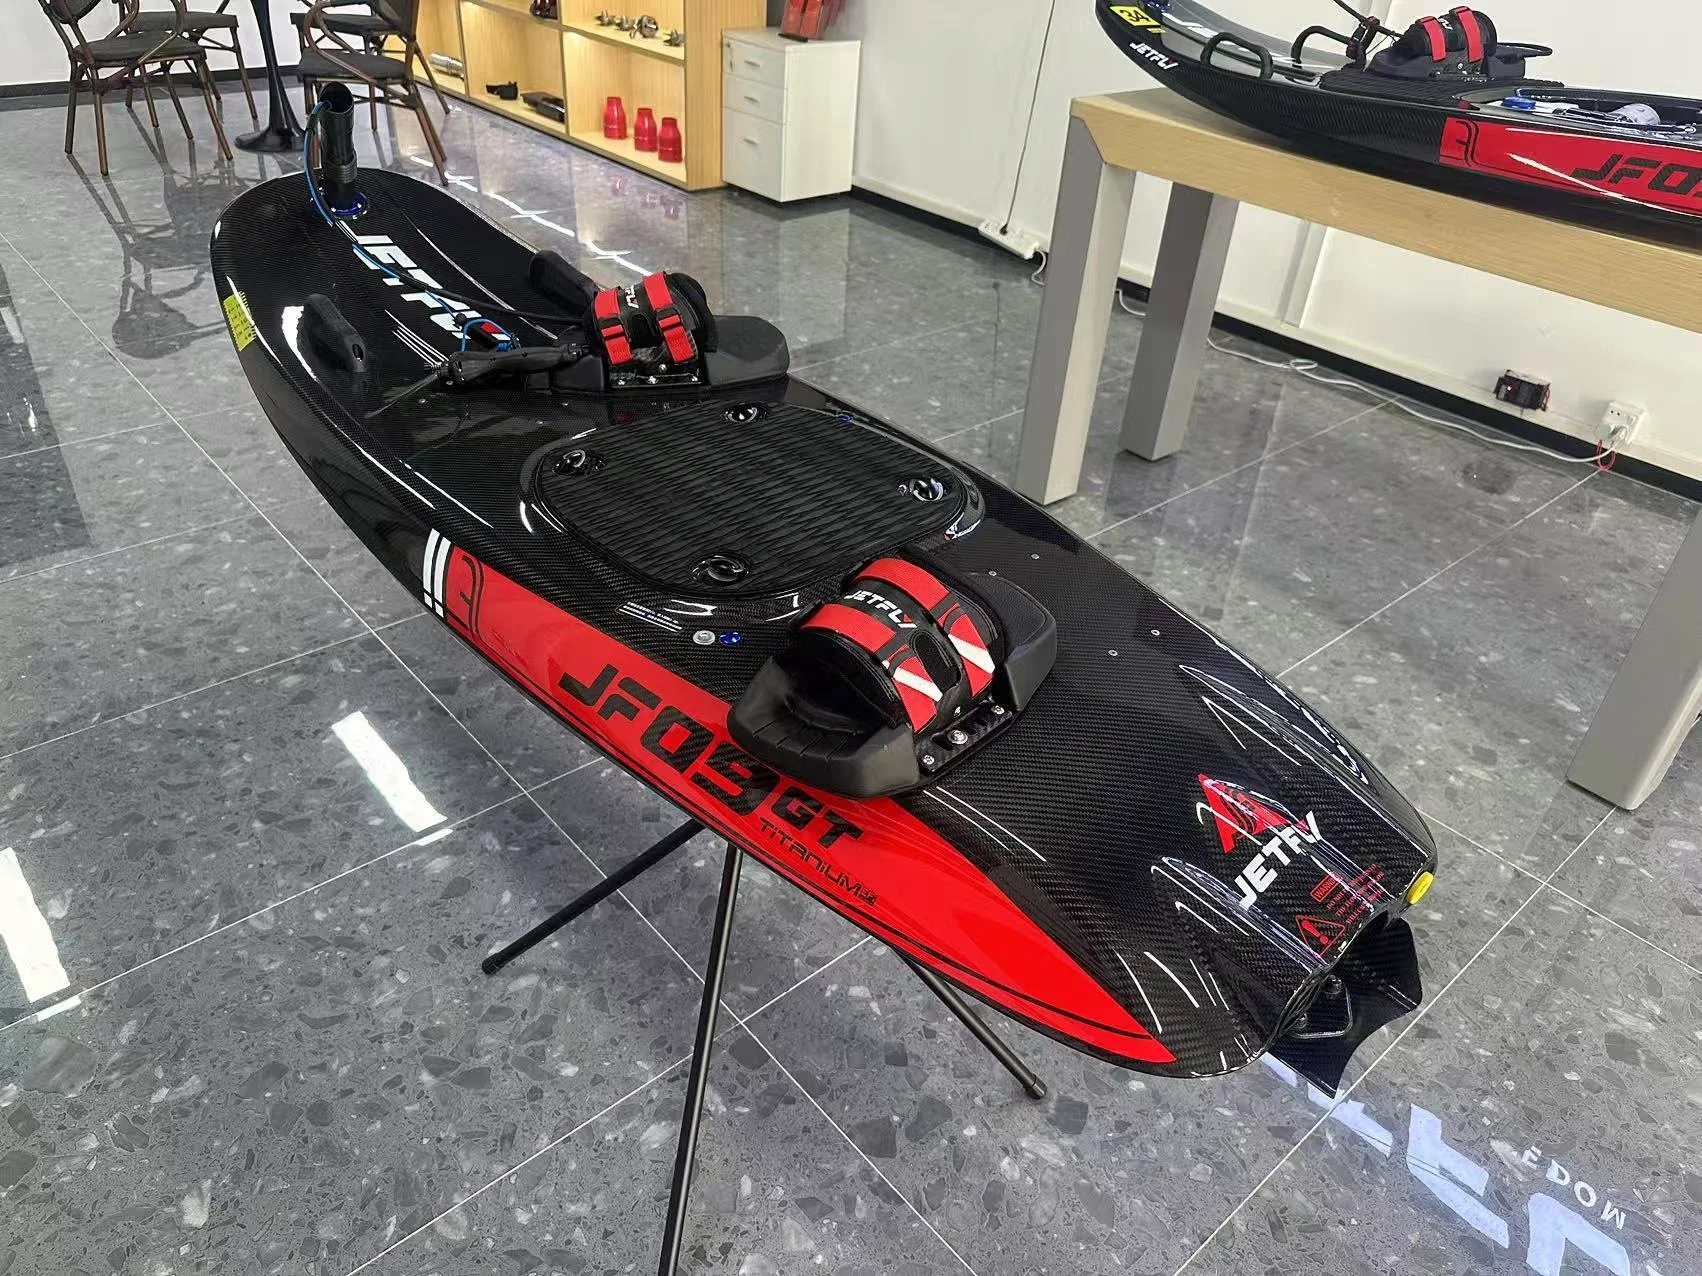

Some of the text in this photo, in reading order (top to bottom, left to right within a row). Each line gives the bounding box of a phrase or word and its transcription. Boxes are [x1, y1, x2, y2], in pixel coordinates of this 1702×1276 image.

[1129, 41, 1179, 70] JETFLY
[1570, 153, 1702, 198] JF0
[844, 589, 918, 629] JETFLY
[771, 786, 865, 849] GT
[1234, 811, 1322, 911] JETFLY
